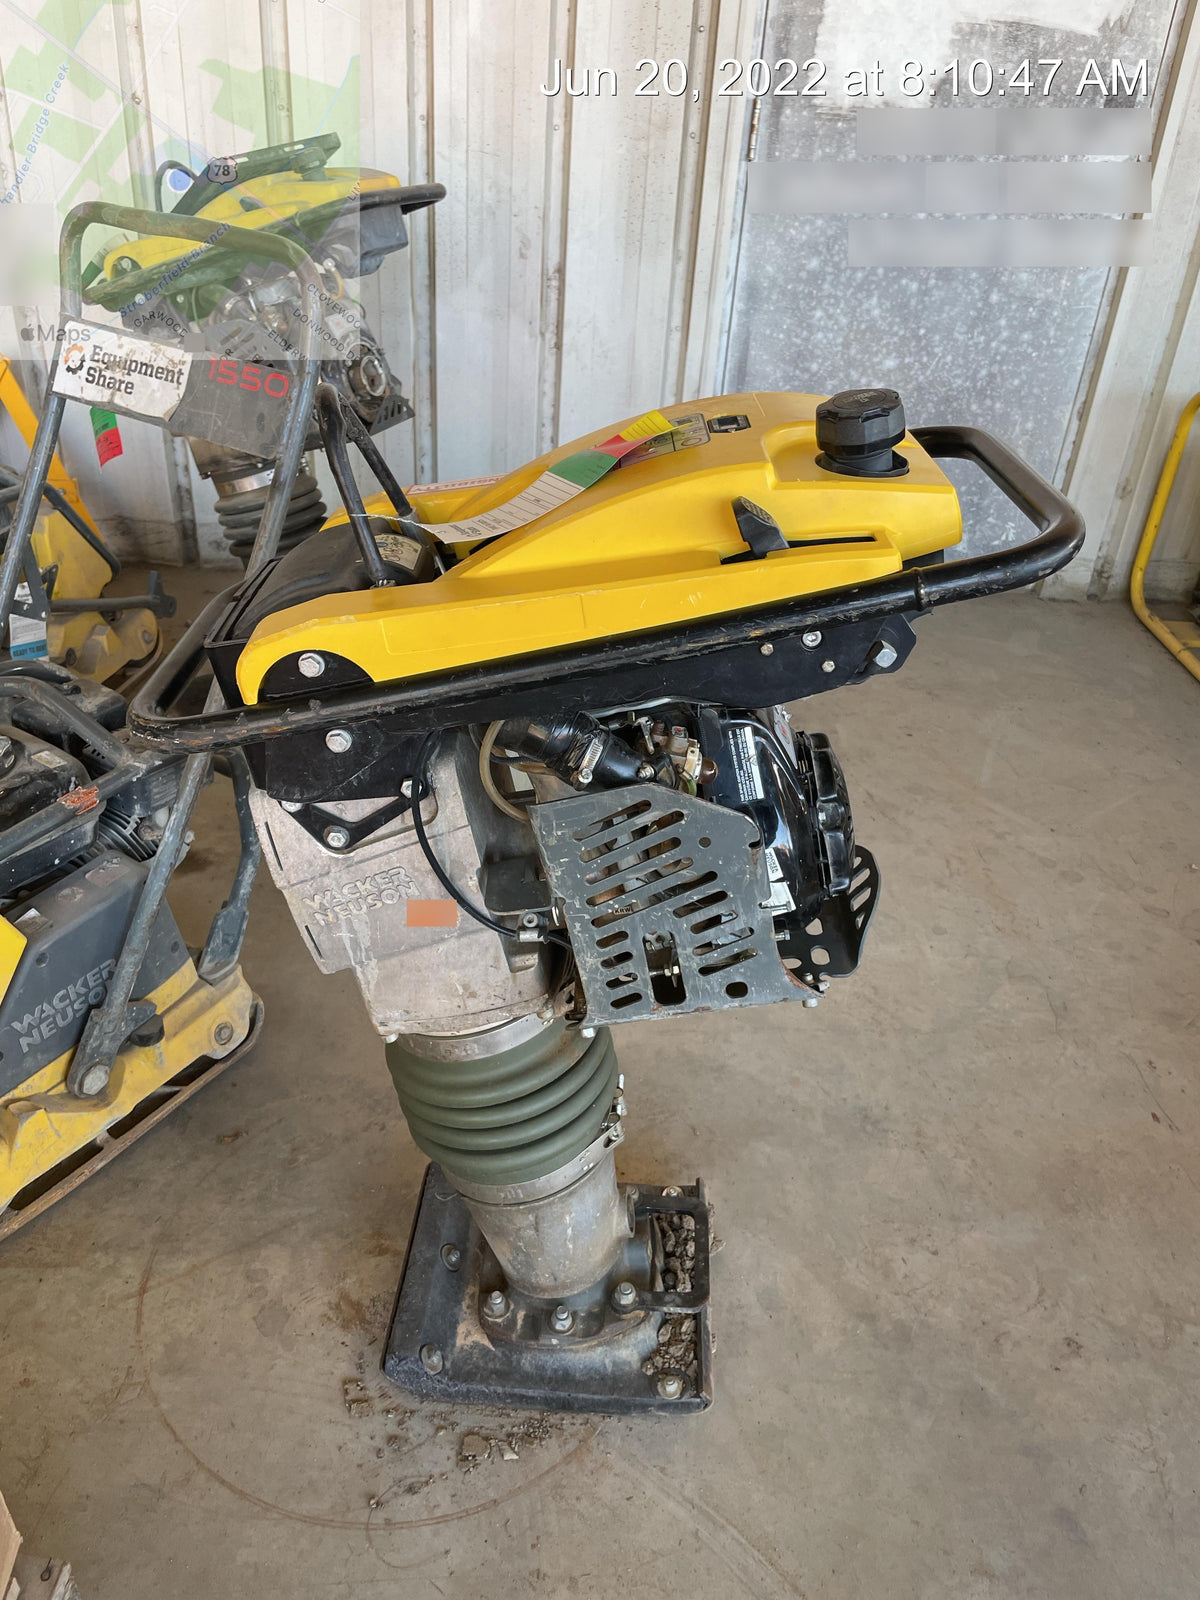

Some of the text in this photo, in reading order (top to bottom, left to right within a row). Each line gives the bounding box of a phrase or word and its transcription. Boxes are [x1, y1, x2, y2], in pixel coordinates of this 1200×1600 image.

[85, 364, 135, 396] Share
[90, 344, 185, 386] Equipment
[208, 357, 290, 398] 1550
[302, 865, 413, 910] WACKER
[313, 880, 421, 927] NEUSON
[10, 958, 117, 1035] WACKER
[19, 986, 108, 1054] NEUSO
